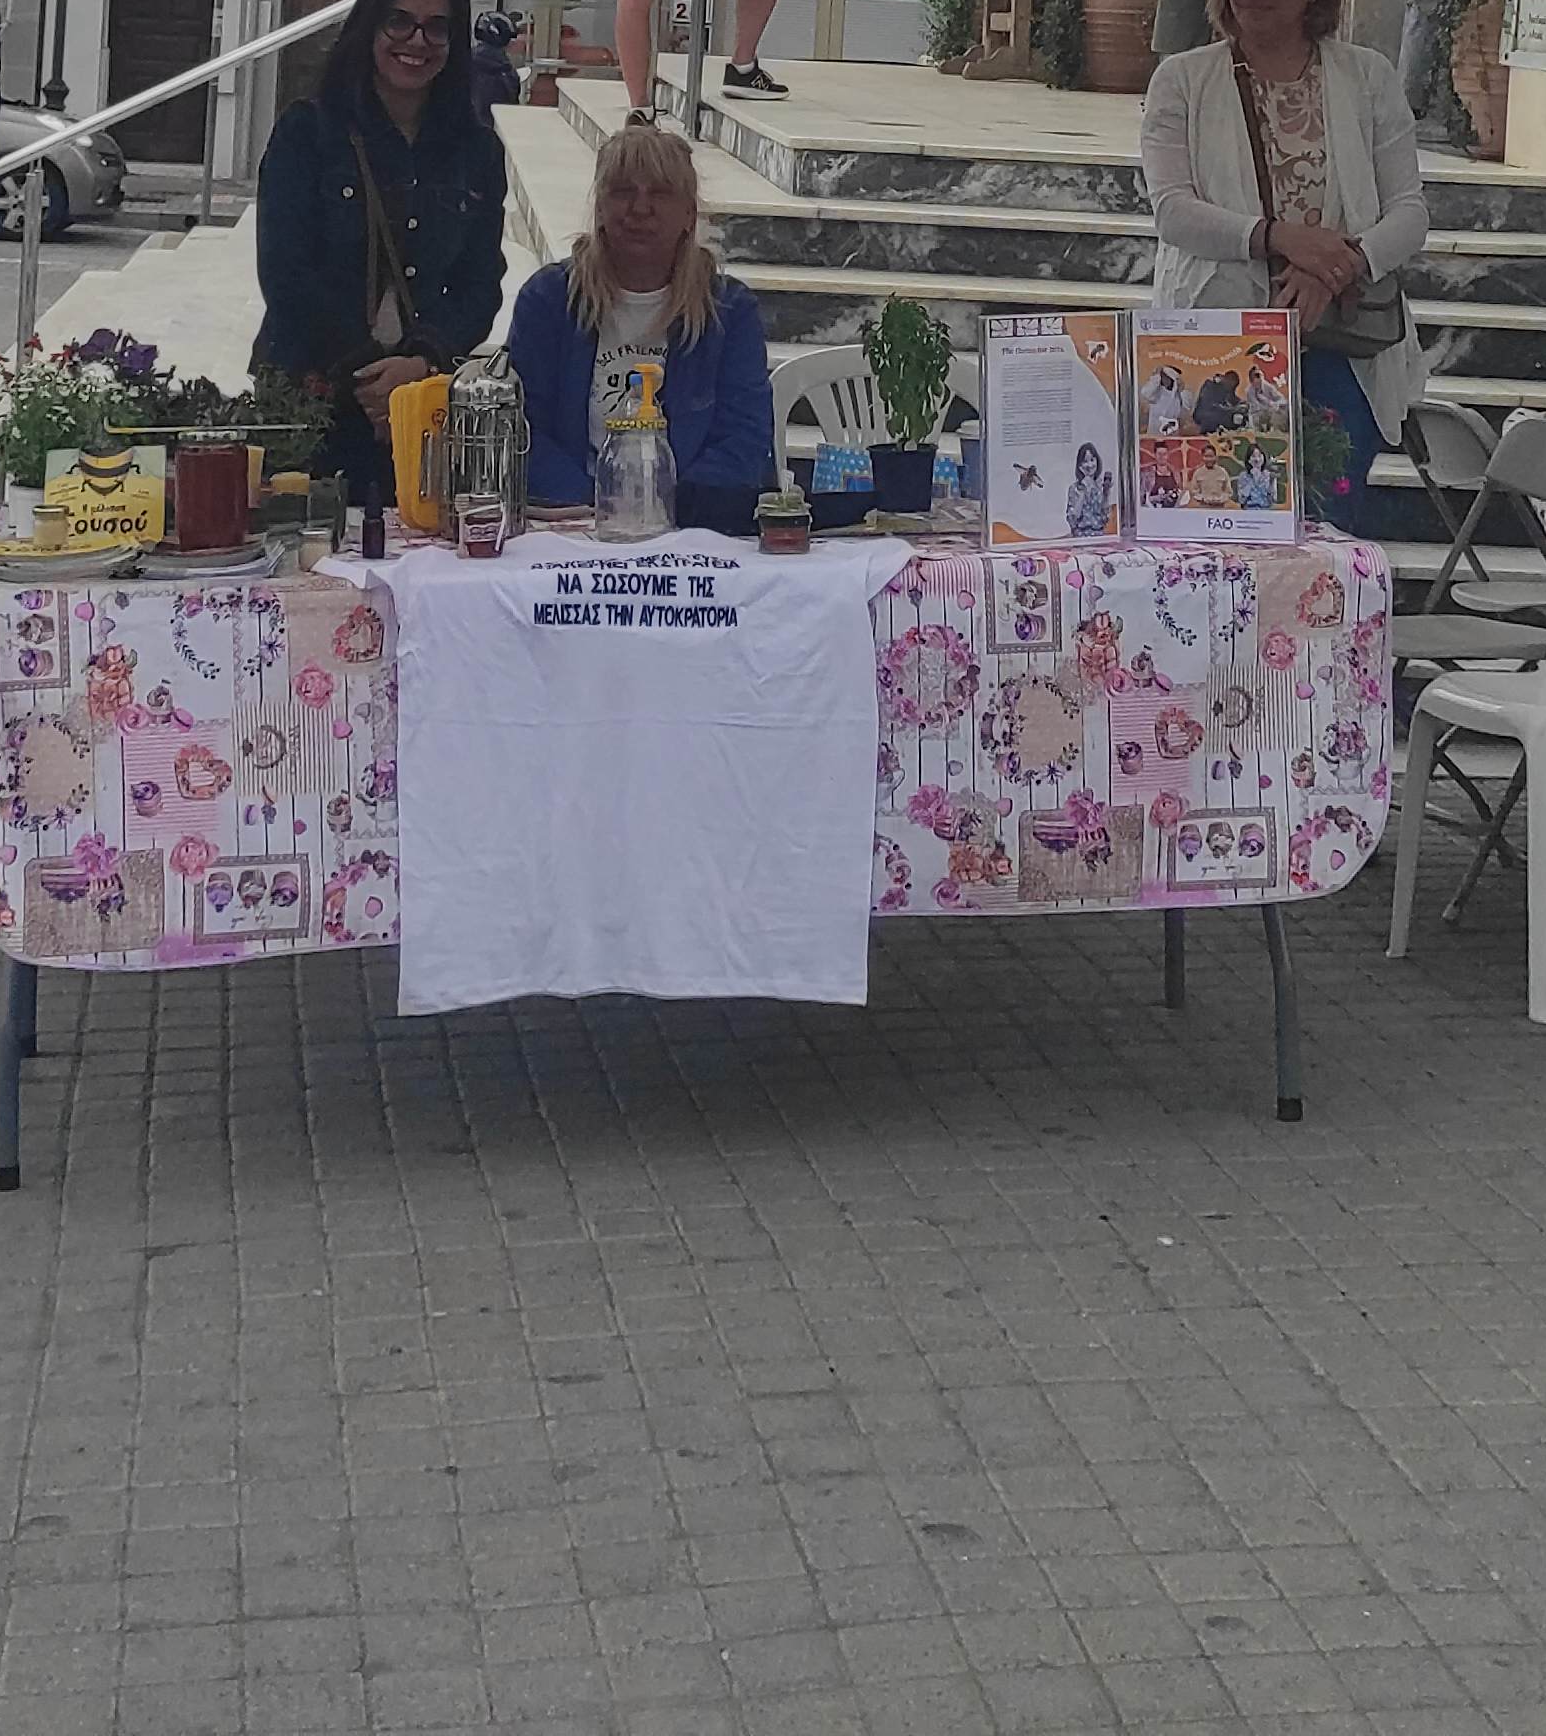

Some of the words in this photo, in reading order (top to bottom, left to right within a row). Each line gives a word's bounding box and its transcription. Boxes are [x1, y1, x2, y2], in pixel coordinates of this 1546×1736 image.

[676, 2, 689, 19] 2
[68, 509, 148, 538] ουσού
[1207, 517, 1234, 531] FAO
[556, 572, 583, 595] ΝΑ
[590, 572, 678, 597] ΣΩΣΟΥΜΕ
[687, 575, 716, 598] ΤΗΣ
[533, 602, 602, 626] ΜΕΛΙΣΣΑΣ
[605, 603, 634, 627] ΤΗΝ
[639, 604, 738, 628] ΑΥΤΟΚΡΑΤΟΡΙΑ
